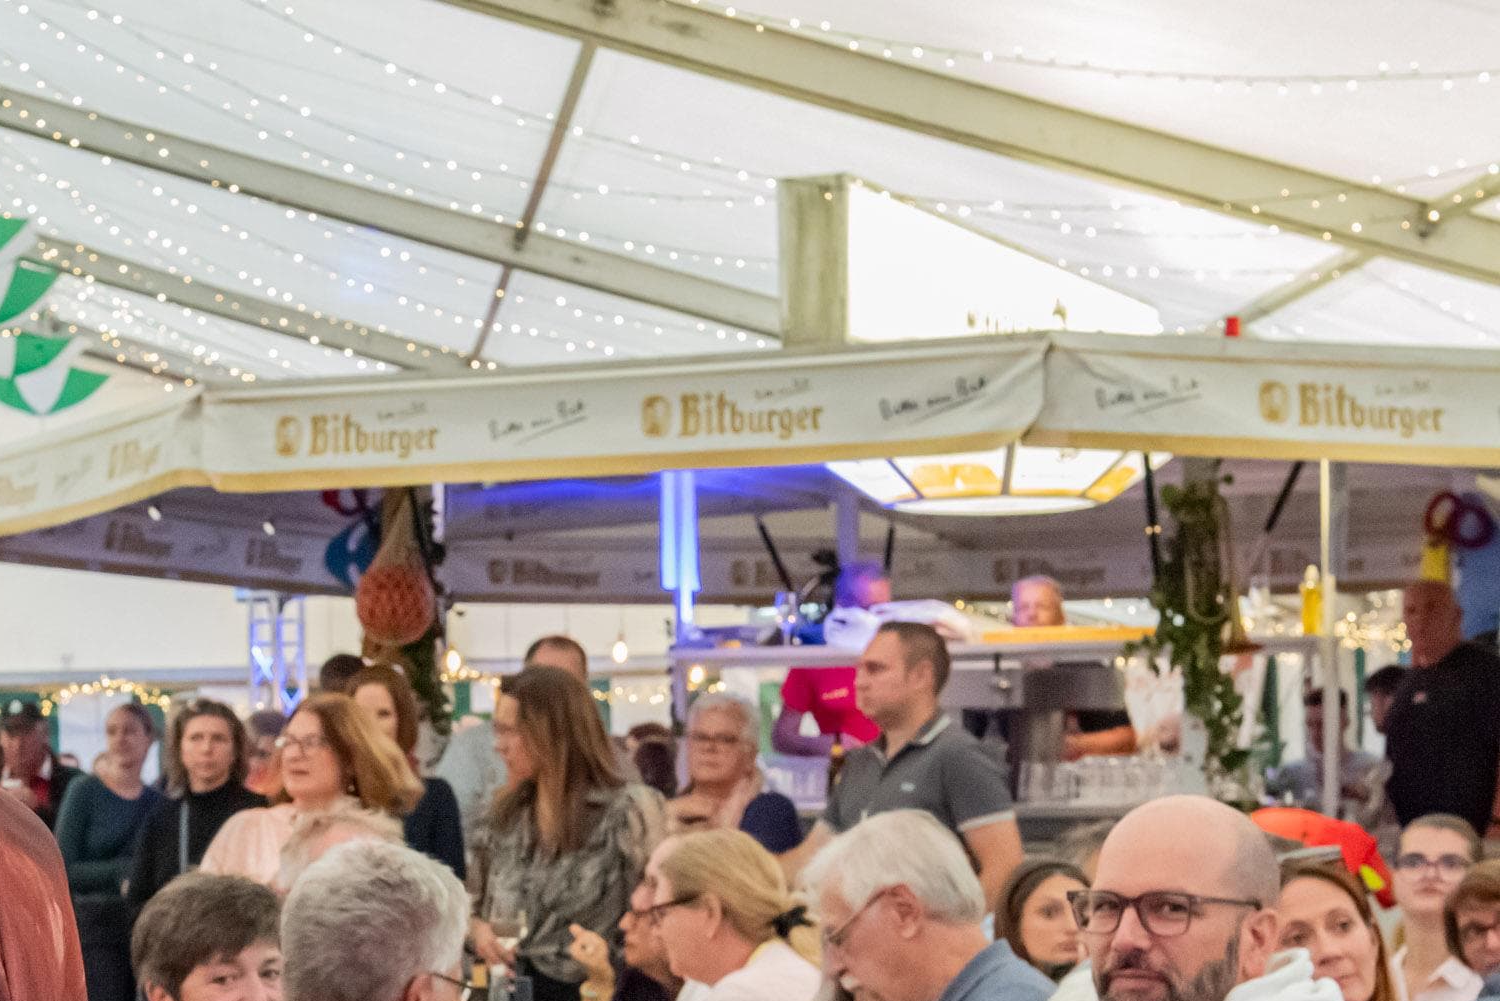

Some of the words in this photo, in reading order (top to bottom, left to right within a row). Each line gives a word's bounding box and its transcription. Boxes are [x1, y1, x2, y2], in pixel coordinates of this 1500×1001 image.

[678, 391, 824, 440] Bitburger
[1298, 381, 1445, 439] Bitburger
[309, 413, 439, 459] Bitburger
